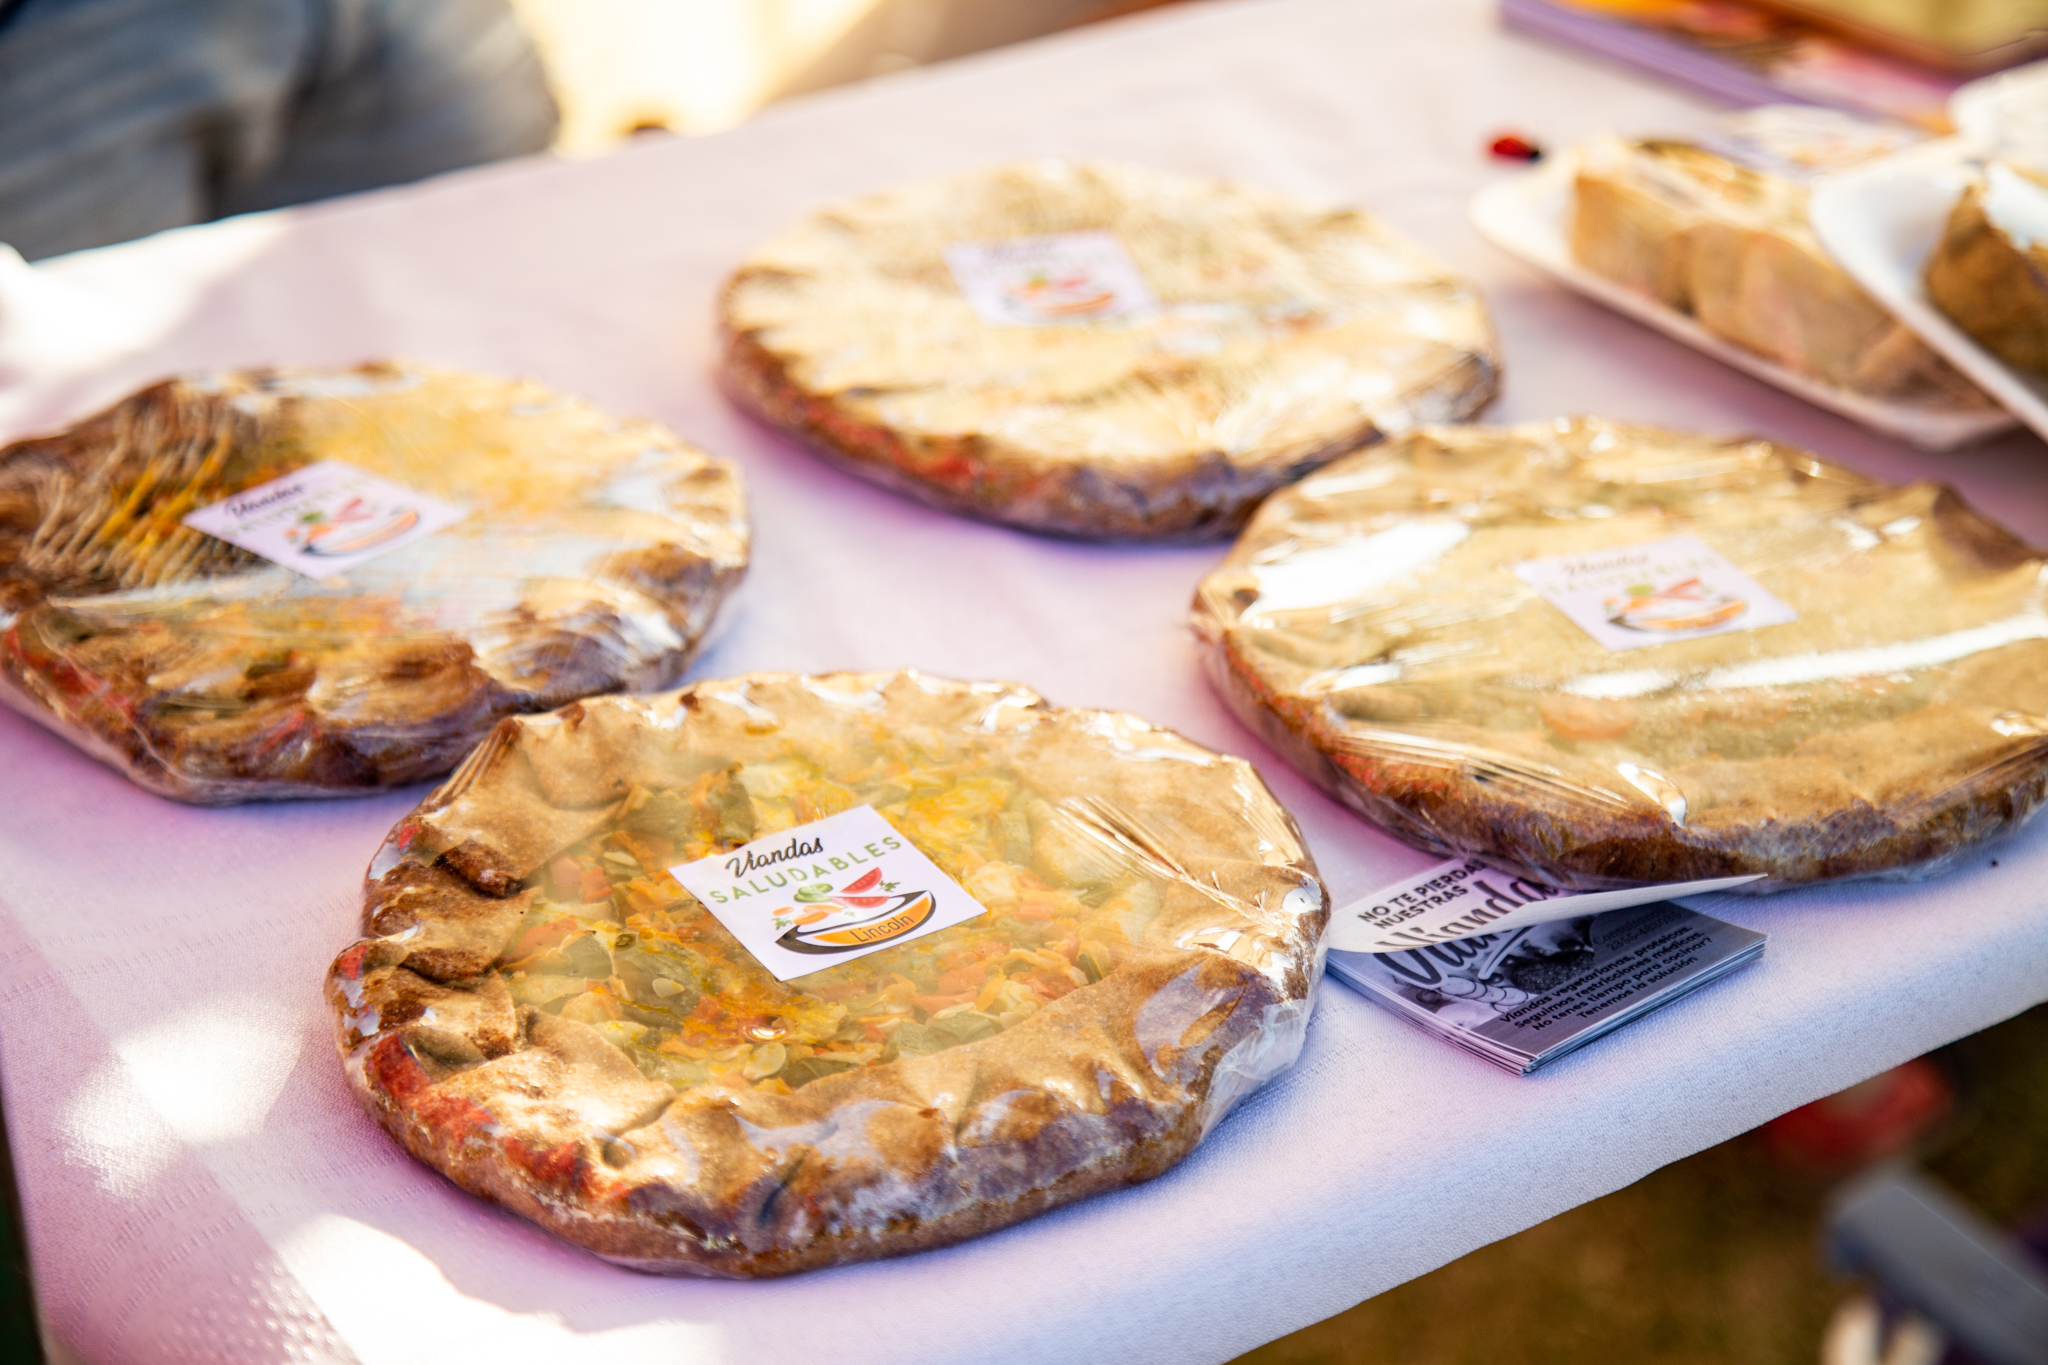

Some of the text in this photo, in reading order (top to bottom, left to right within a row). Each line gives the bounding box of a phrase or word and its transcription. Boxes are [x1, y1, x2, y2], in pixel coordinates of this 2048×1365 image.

[709, 836, 901, 904] SALUDABLES
[725, 837, 824, 878] Viandas
[850, 914, 915, 943] Lincoln
[1358, 905, 1391, 923] NO
[1388, 893, 1413, 908] TE
[1373, 885, 1468, 929] NUESTRAS
[1500, 996, 1552, 1022] Viandas
[1552, 956, 1635, 997] vegetarianas,
[1514, 996, 1575, 1028] Seguimos
[1576, 957, 1651, 997] restricciones
[1532, 937, 1712, 1031] No tenes tiempo para cocinar?
[1577, 957, 1698, 1018] Tenemos la solución
